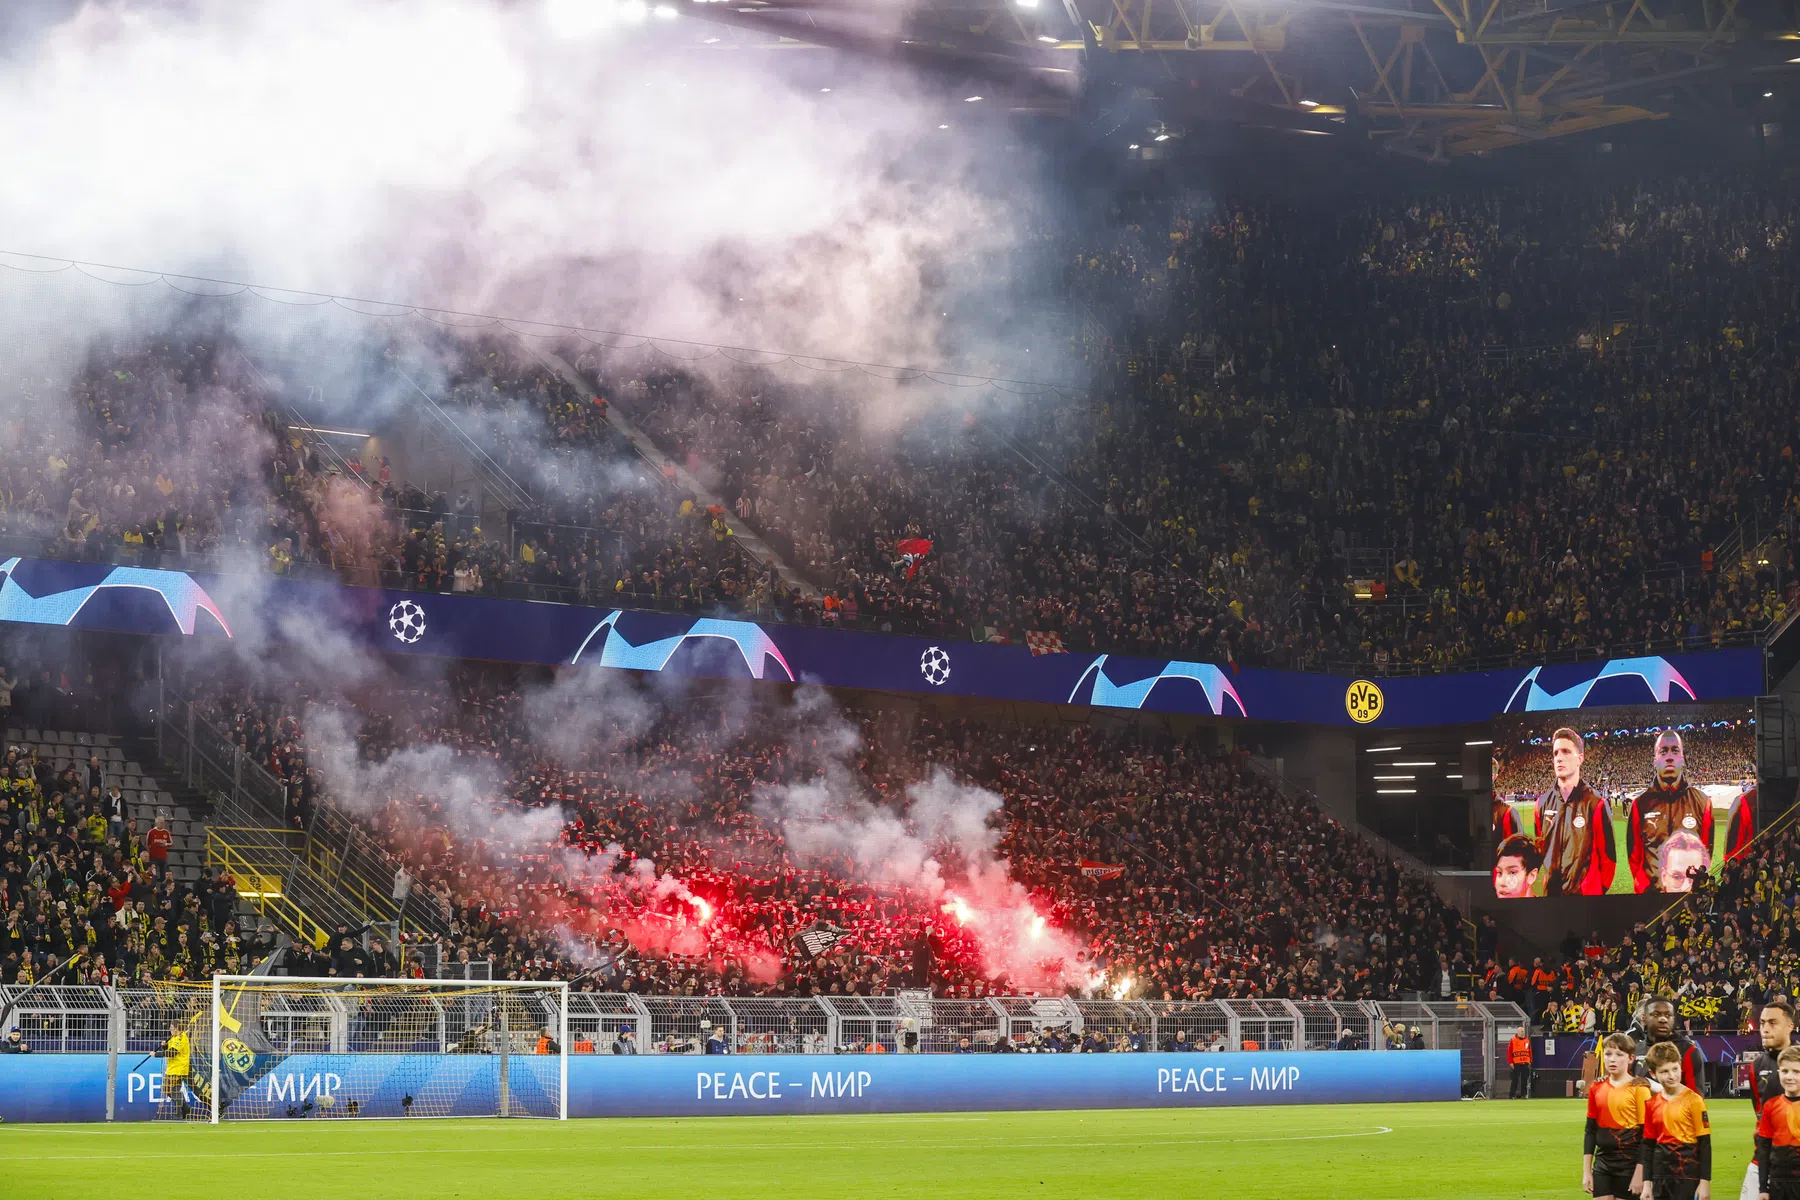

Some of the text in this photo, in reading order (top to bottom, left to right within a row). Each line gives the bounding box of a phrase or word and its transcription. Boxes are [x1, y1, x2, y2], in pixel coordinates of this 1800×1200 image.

[304, 385, 325, 402] 71
[1350, 685, 1378, 710] BVB
[1357, 709, 1368, 719] 09
[226, 1041, 250, 1068] BVB
[267, 1072, 341, 1102] МИР
[697, 1071, 782, 1100] PEACE
[810, 1071, 872, 1098] МИР
[1158, 1067, 1227, 1093] PEACE
[1250, 1066, 1300, 1091] МИР
